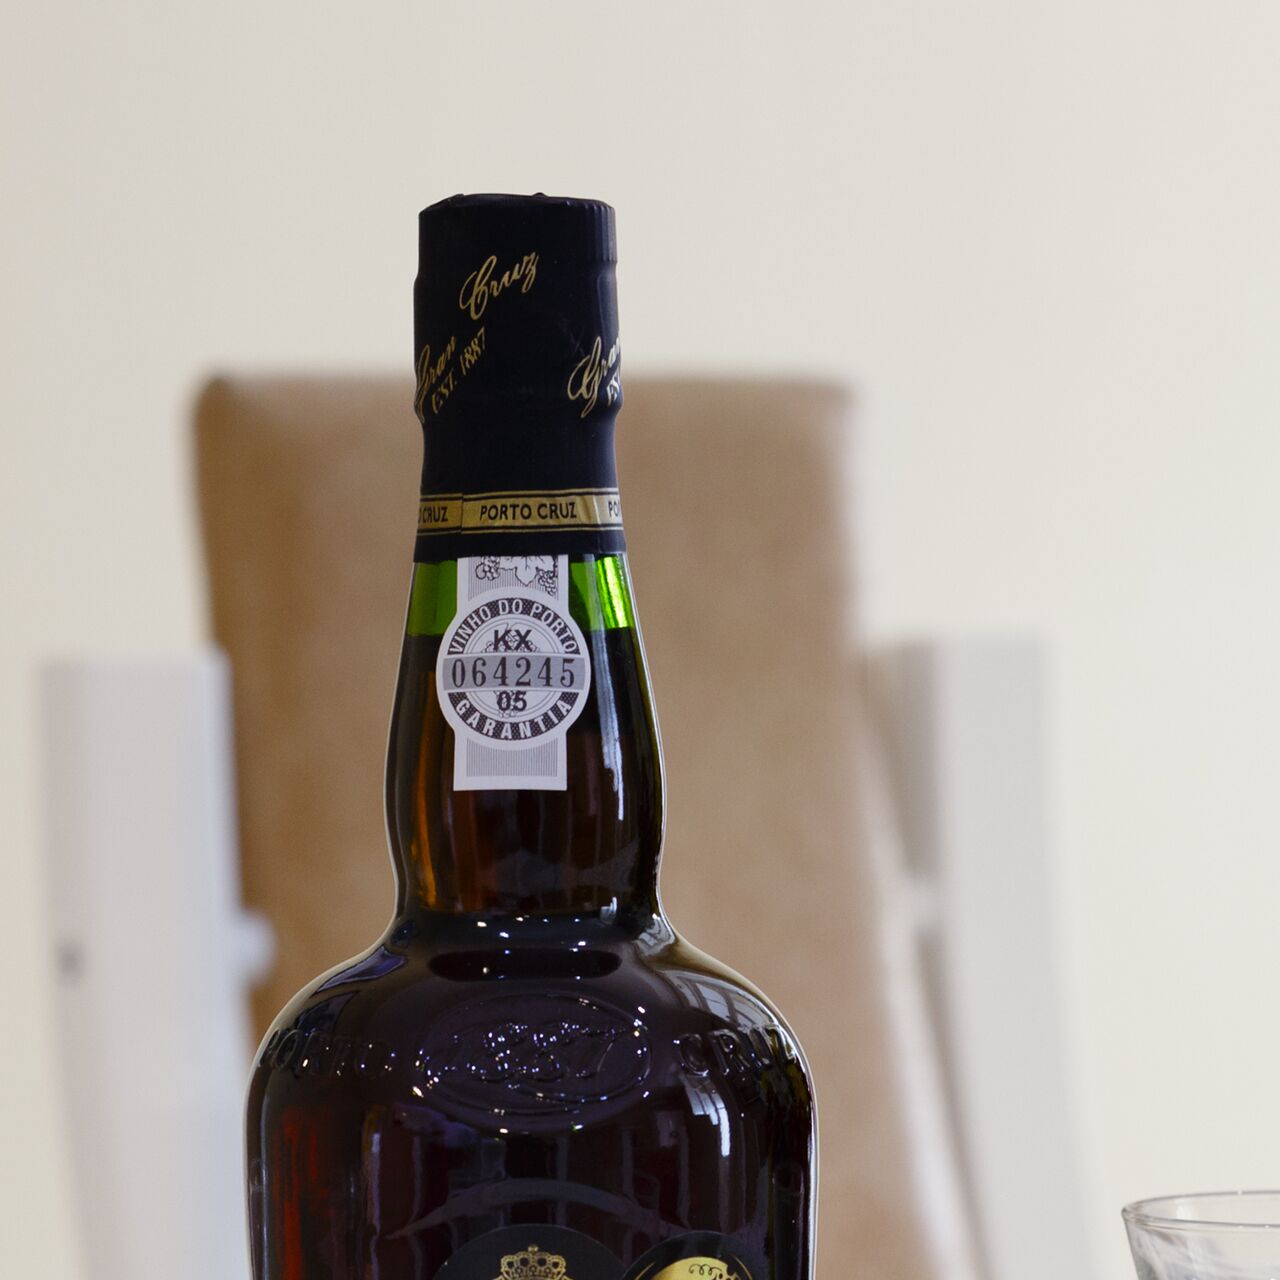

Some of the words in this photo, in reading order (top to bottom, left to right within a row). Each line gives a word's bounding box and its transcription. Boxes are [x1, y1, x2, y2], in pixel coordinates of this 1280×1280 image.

[459, 251, 540, 321] Cruz
[460, 326, 486, 376] 1887
[480, 503, 532, 521] PORTO
[537, 501, 577, 520] CRUZ
[449, 604, 492, 655] VINHO
[498, 598, 524, 616] DO
[530, 600, 578, 653] PORTO
[493, 629, 533, 652] KX
[451, 656, 576, 688] 064245
[455, 698, 573, 740] GARANTIA
[496, 690, 528, 712] 05
